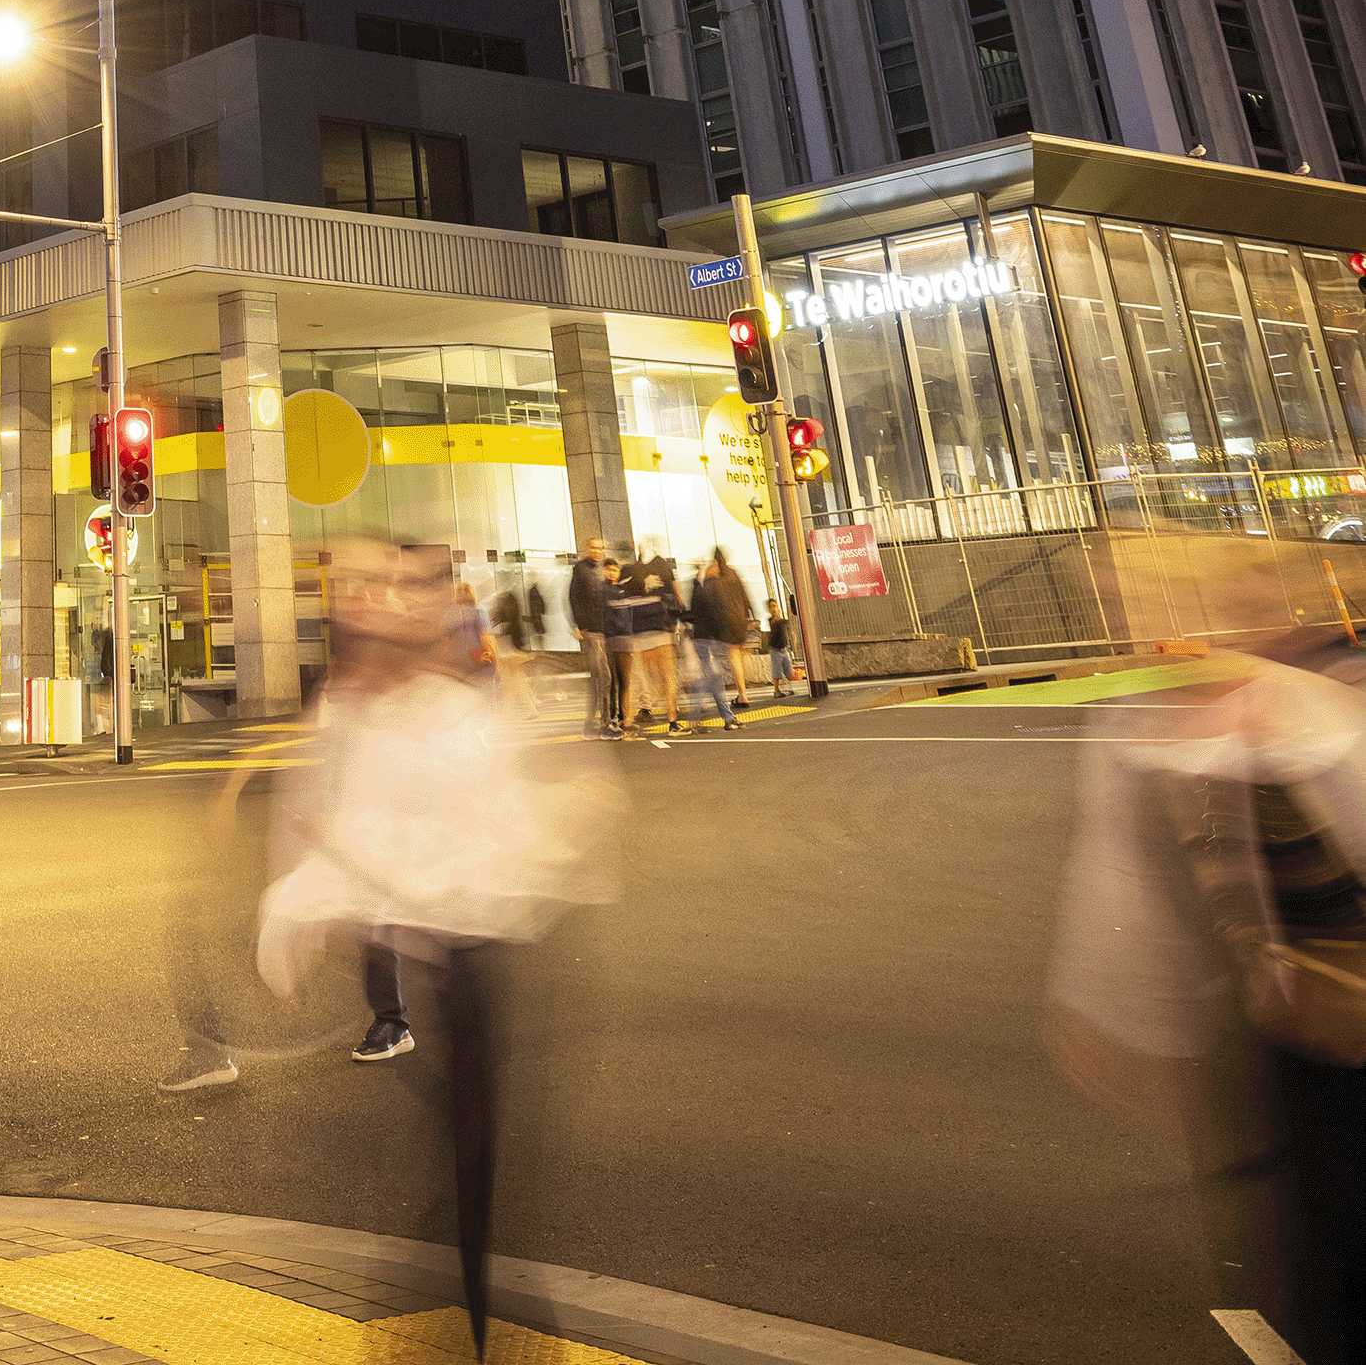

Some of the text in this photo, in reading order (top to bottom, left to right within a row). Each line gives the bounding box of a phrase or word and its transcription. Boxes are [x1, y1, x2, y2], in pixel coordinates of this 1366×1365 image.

[697, 261, 738, 284] Albert St
[787, 256, 1009, 326] Te Waihorotiu
[730, 452, 754, 466] here
[726, 469, 766, 487] help yo
